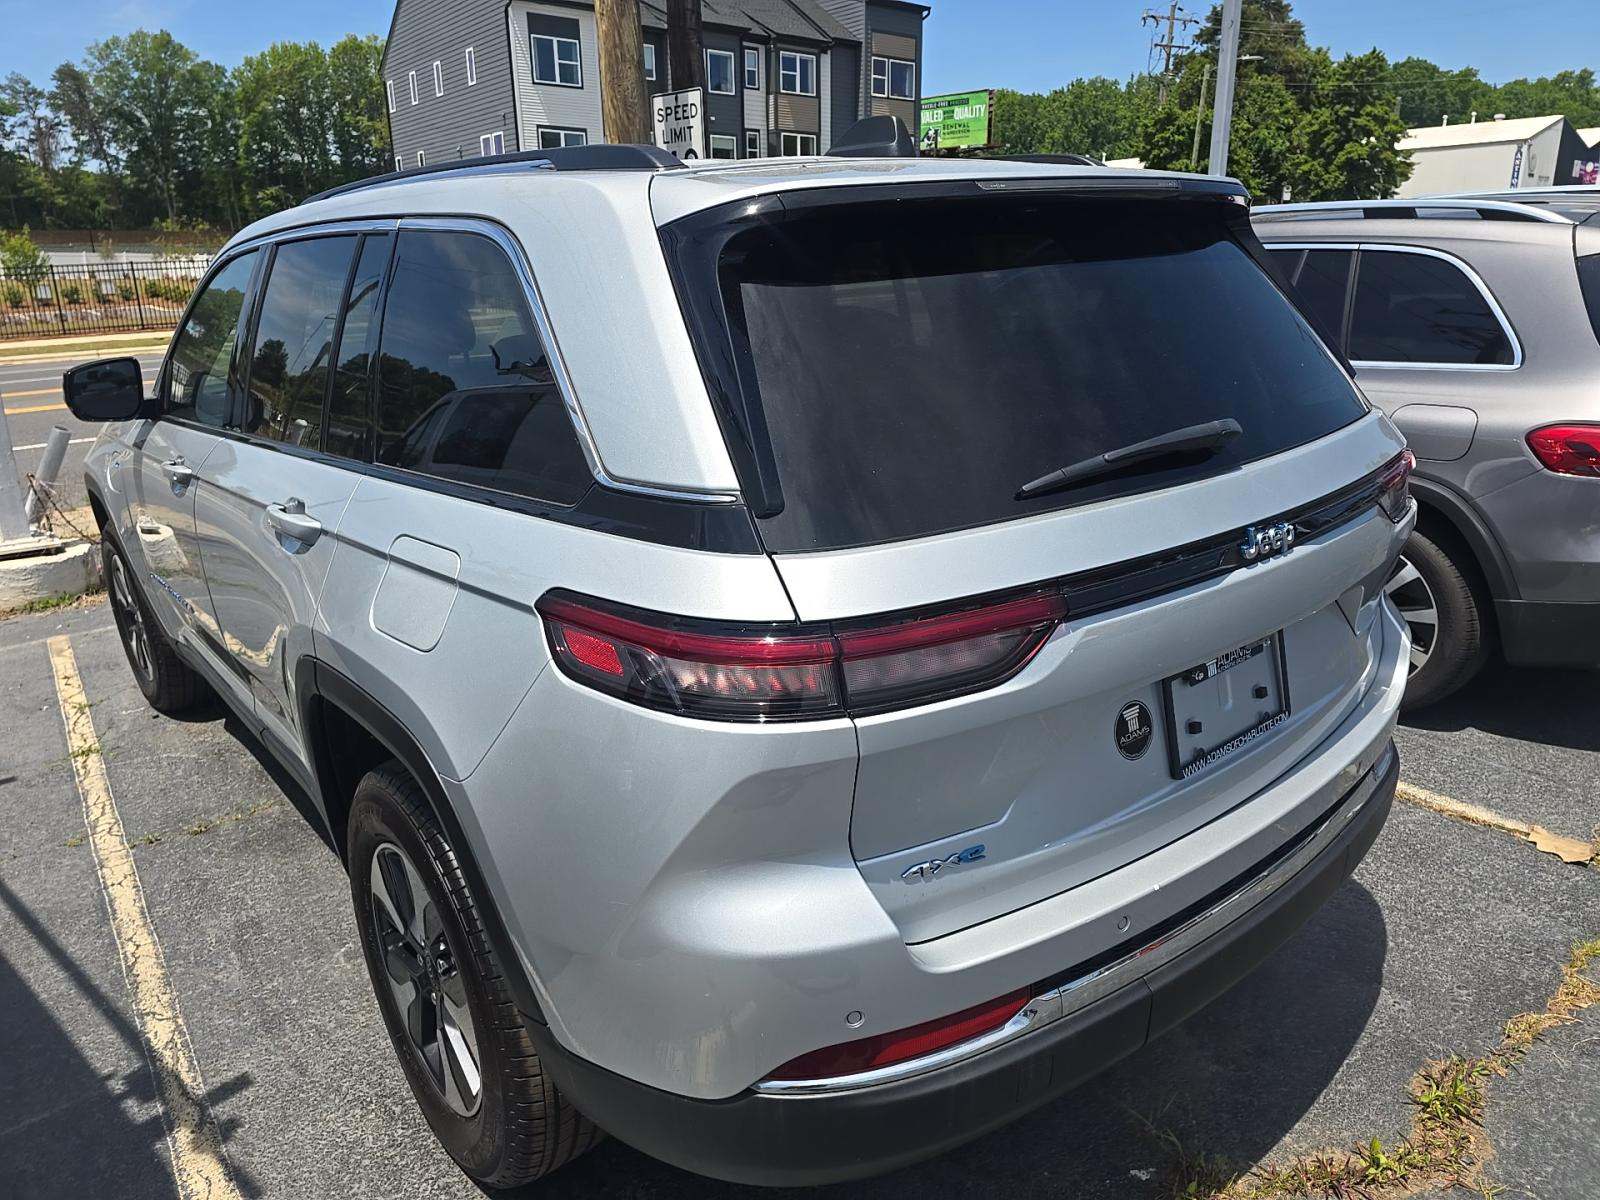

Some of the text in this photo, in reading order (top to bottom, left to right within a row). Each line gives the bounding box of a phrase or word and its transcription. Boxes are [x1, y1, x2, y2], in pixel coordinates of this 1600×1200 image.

[657, 103, 698, 123] SPEED
[954, 104, 986, 120] QUALITY
[662, 126, 694, 145] LIMIT
[1241, 523, 1295, 559] Jeep
[1120, 725, 1150, 744] ADAMS
[1183, 711, 1290, 779] WWW.ADAMSOFCHARLOTTE.COM
